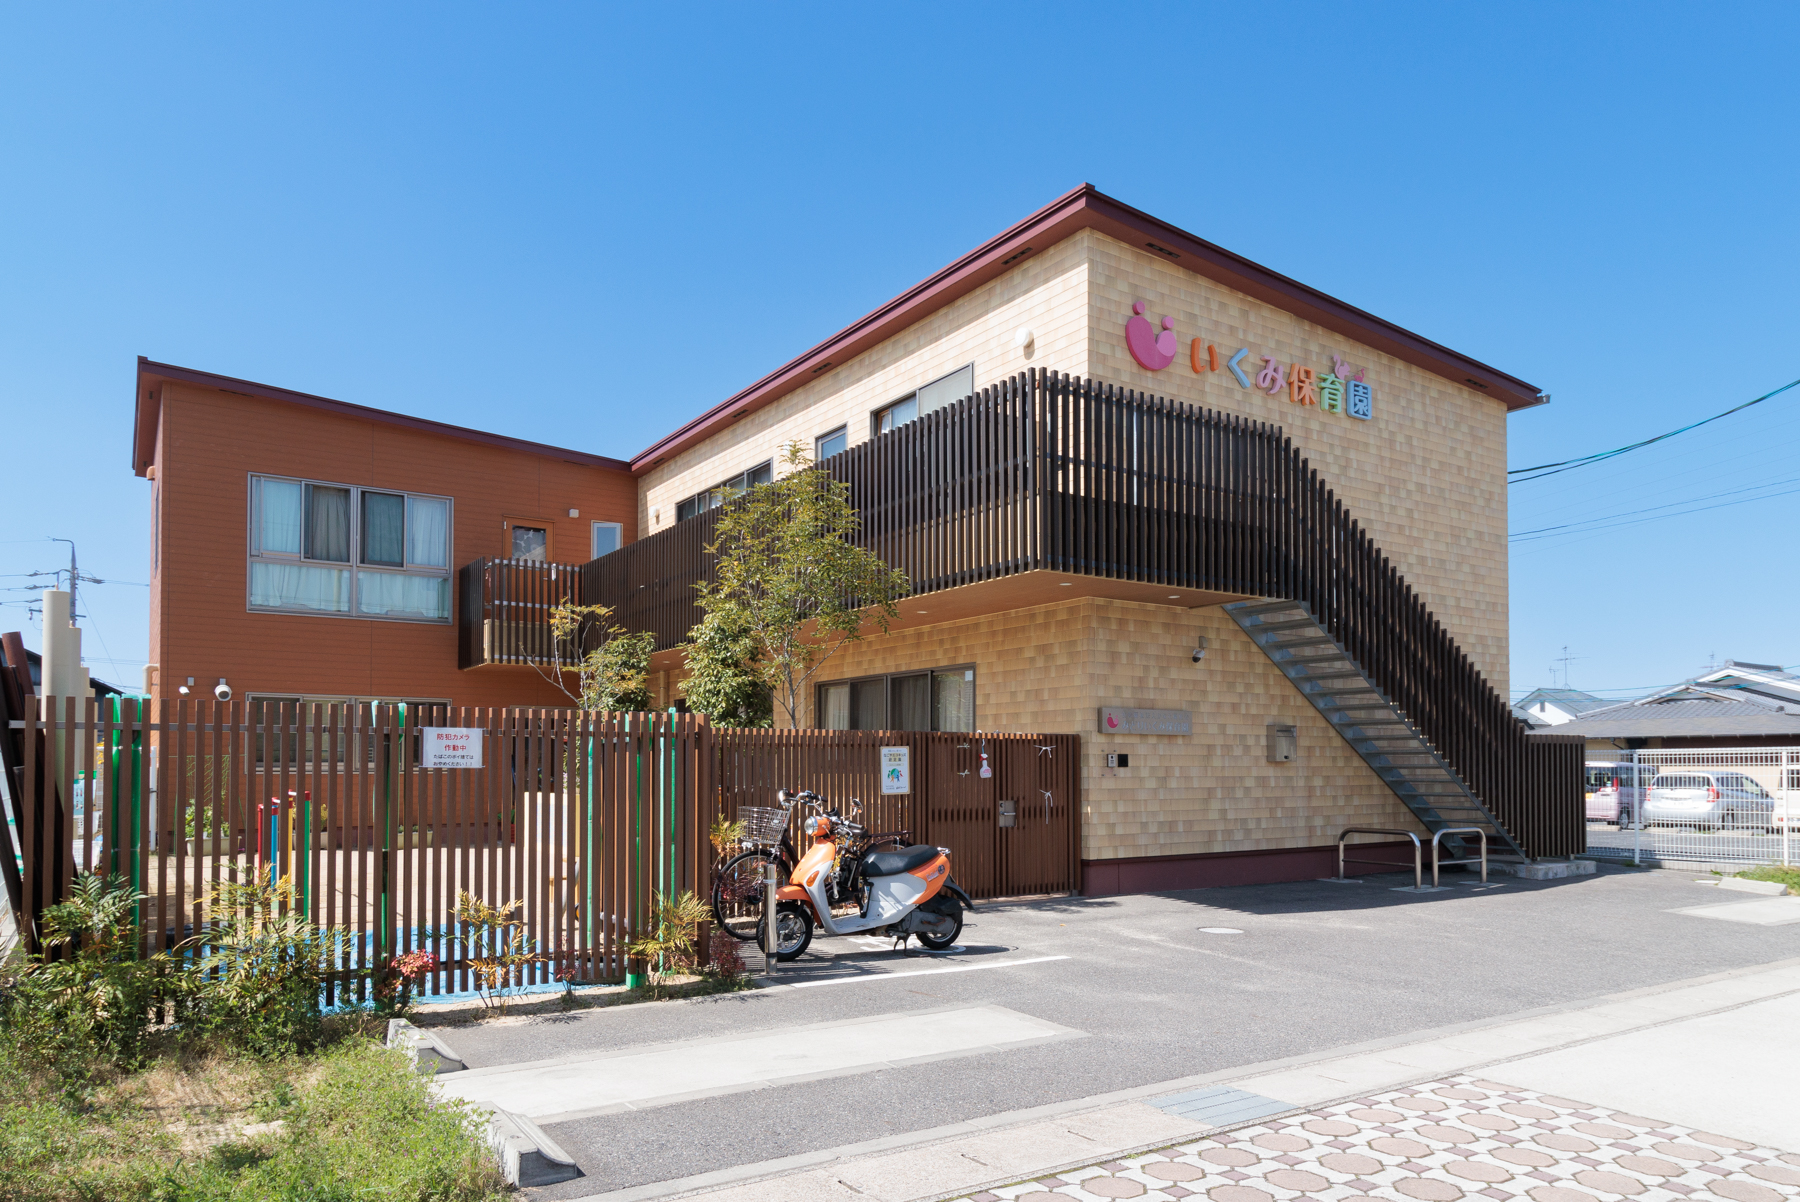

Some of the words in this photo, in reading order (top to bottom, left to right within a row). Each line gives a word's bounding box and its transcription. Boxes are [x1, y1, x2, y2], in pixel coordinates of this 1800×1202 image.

[1190, 337, 1373, 421] いくみ保育園
[1122, 720, 1189, 732] みどりいくみ保育園
